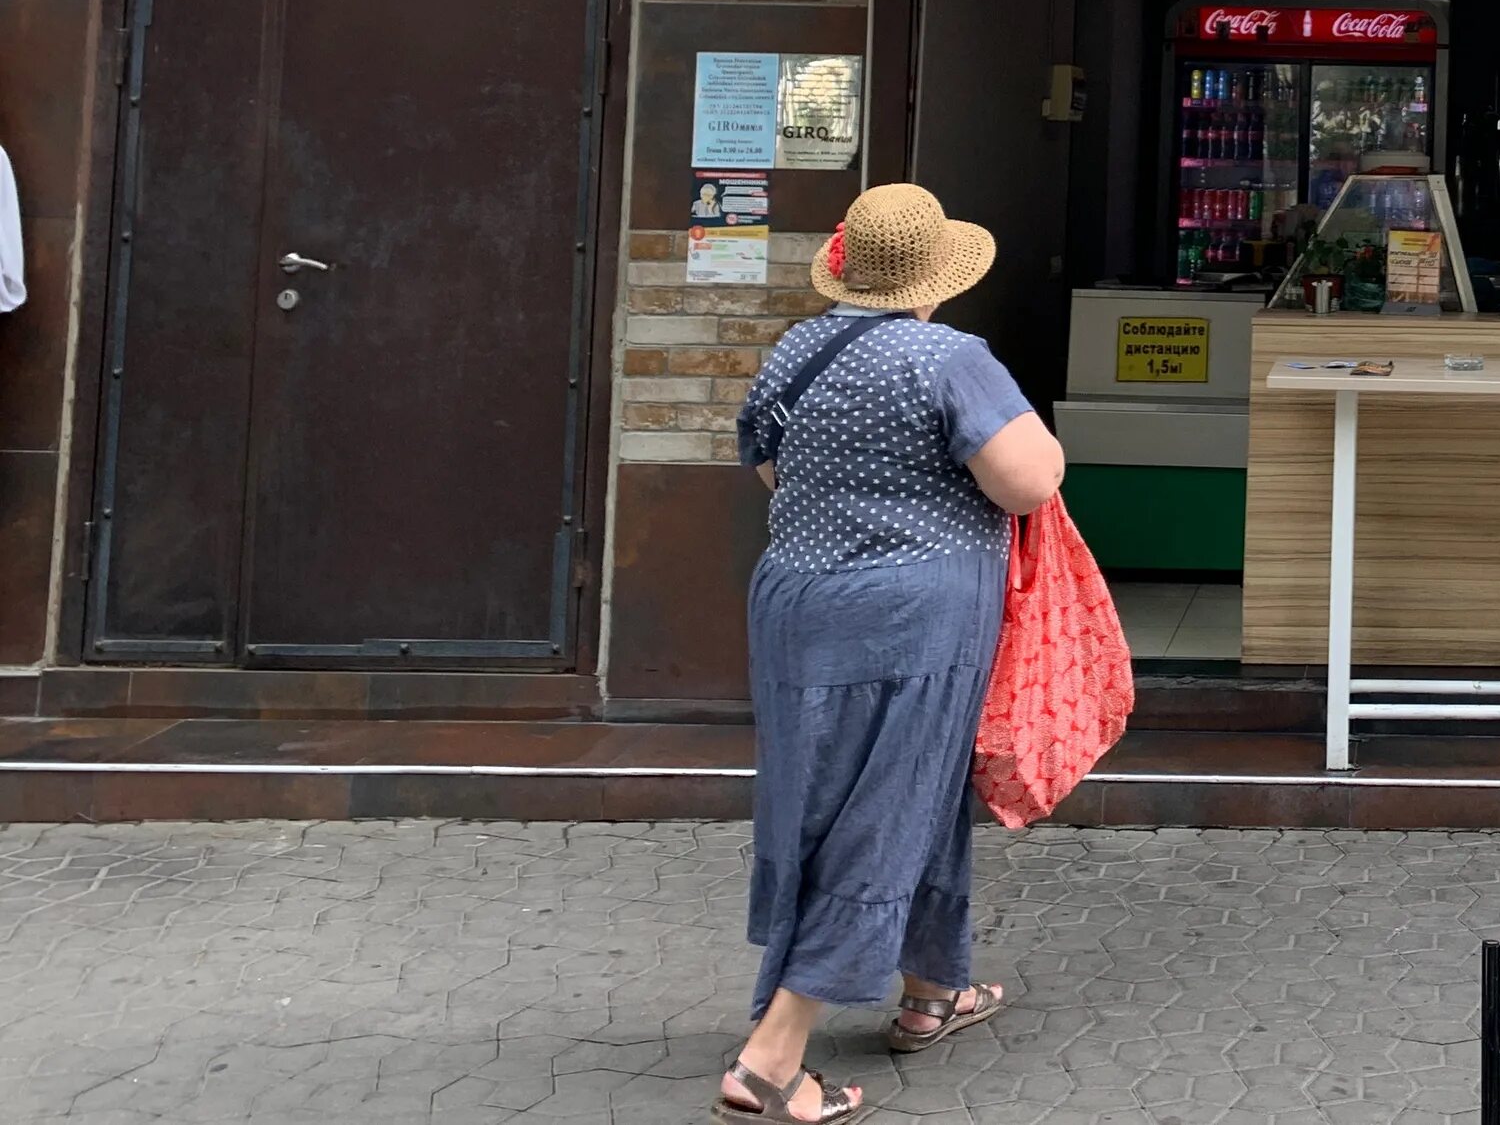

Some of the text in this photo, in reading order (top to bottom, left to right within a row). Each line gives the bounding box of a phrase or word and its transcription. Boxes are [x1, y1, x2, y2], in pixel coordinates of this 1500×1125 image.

[1332, 12, 1410, 38] Coca-Cola
[783, 125, 829, 139] GIRO
[1123, 322, 1205, 338] Соблюдайте
[1125, 344, 1200, 357] дистанцию
